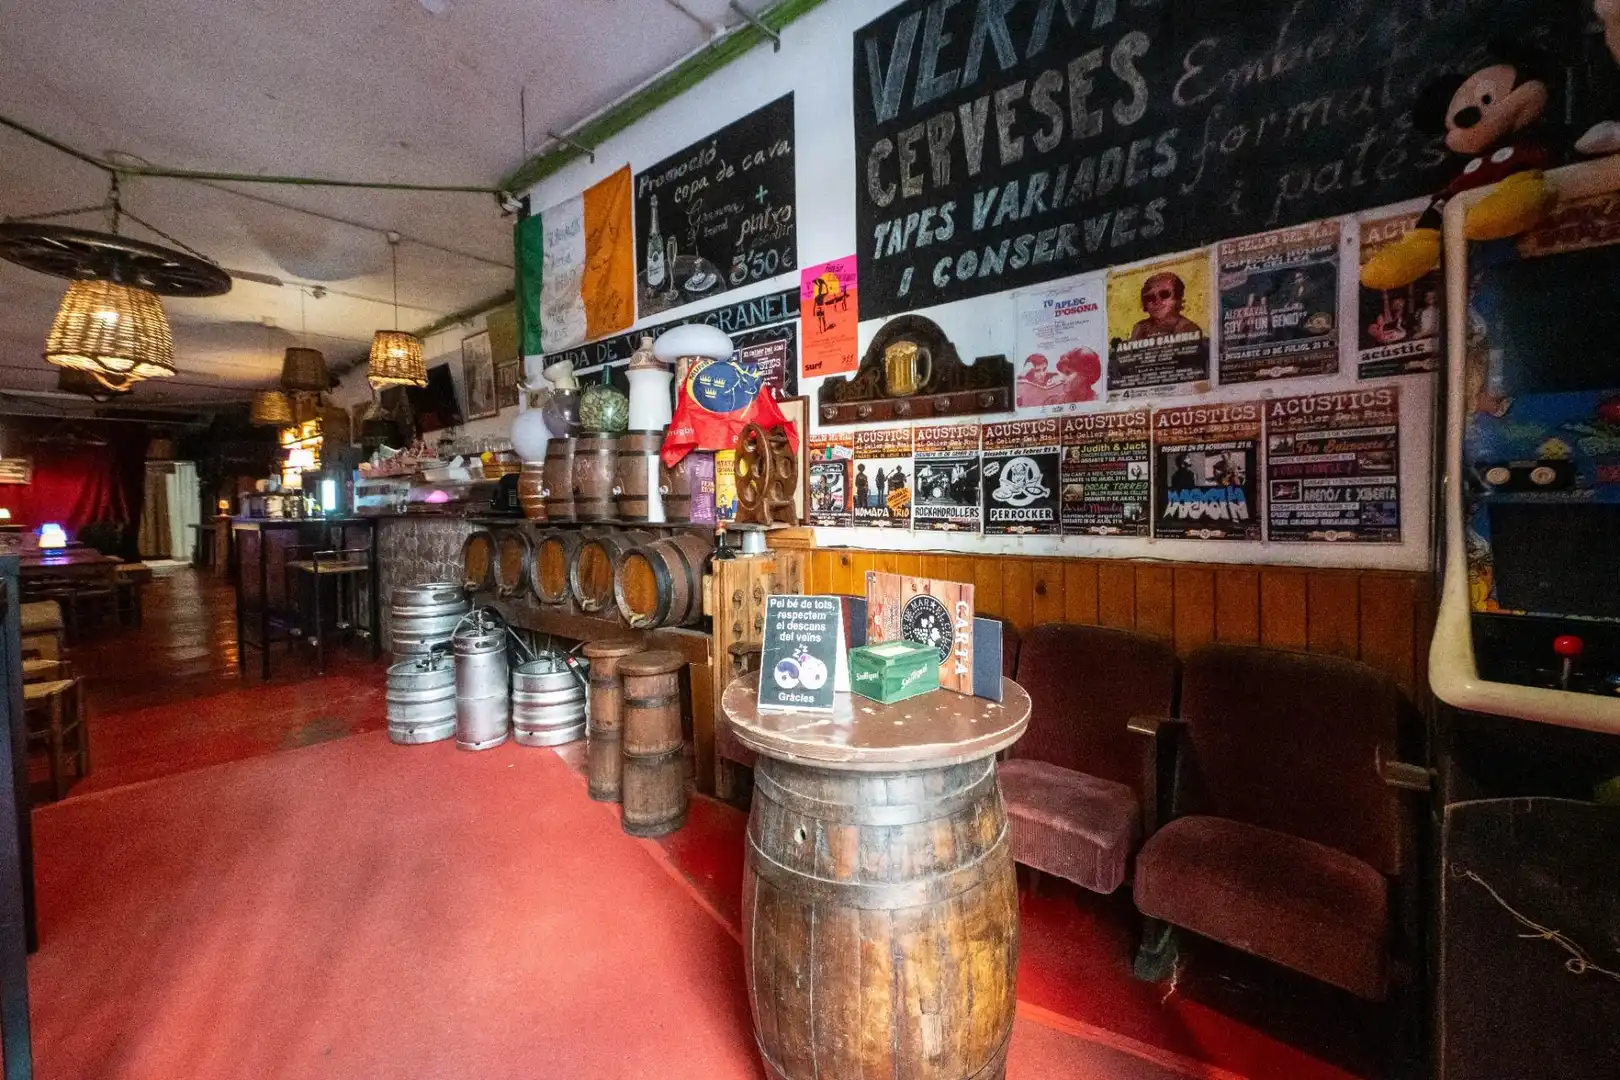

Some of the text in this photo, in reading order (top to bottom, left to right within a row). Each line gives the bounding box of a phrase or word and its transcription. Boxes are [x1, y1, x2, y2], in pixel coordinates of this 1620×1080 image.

[867, 30, 1150, 207] CERVESES
[674, 139, 791, 204] copa de cava
[872, 127, 1180, 260] TAPES VARIADES
[932, 197, 1168, 288] CONSERVES
[1221, 244, 1234, 256] EL
[1238, 235, 1278, 251] CELLER
[1282, 230, 1304, 243] DEL
[1054, 303, 1098, 318] D'OSONA
[1055, 297, 1086, 310] APLEC
[1224, 320, 1242, 335] SOY
[596, 340, 618, 363] DE
[805, 361, 822, 371] surf
[1271, 389, 1391, 417] ACÚSTICS
[1064, 412, 1146, 432] ACÚSTICS
[1158, 404, 1256, 428] ACÚSTICS
[1289, 414, 1329, 424] Celler
[917, 424, 978, 441] ACÚSTICS
[985, 419, 1056, 438] ACÚSTICS
[1076, 431, 1103, 439] Celler
[1172, 427, 1204, 436] Celler
[856, 429, 910, 443] ACÚSTICS
[1080, 442, 1147, 453] Judith & Jack
[855, 507, 889, 517] NOMADA
[892, 507, 909, 517] TRIO
[915, 506, 980, 519] ROCKANDROLLERS
[991, 509, 1053, 520] PERROCKER
[770, 598, 836, 610] Pel bé de tots,
[904, 608, 913, 622] DE
[910, 598, 930, 610] MAR
[777, 611, 826, 621] respectem
[776, 622, 826, 631] el descans
[780, 632, 822, 642] del veïns
[955, 600, 969, 675] CARTA
[778, 692, 815, 703] Gràcies
